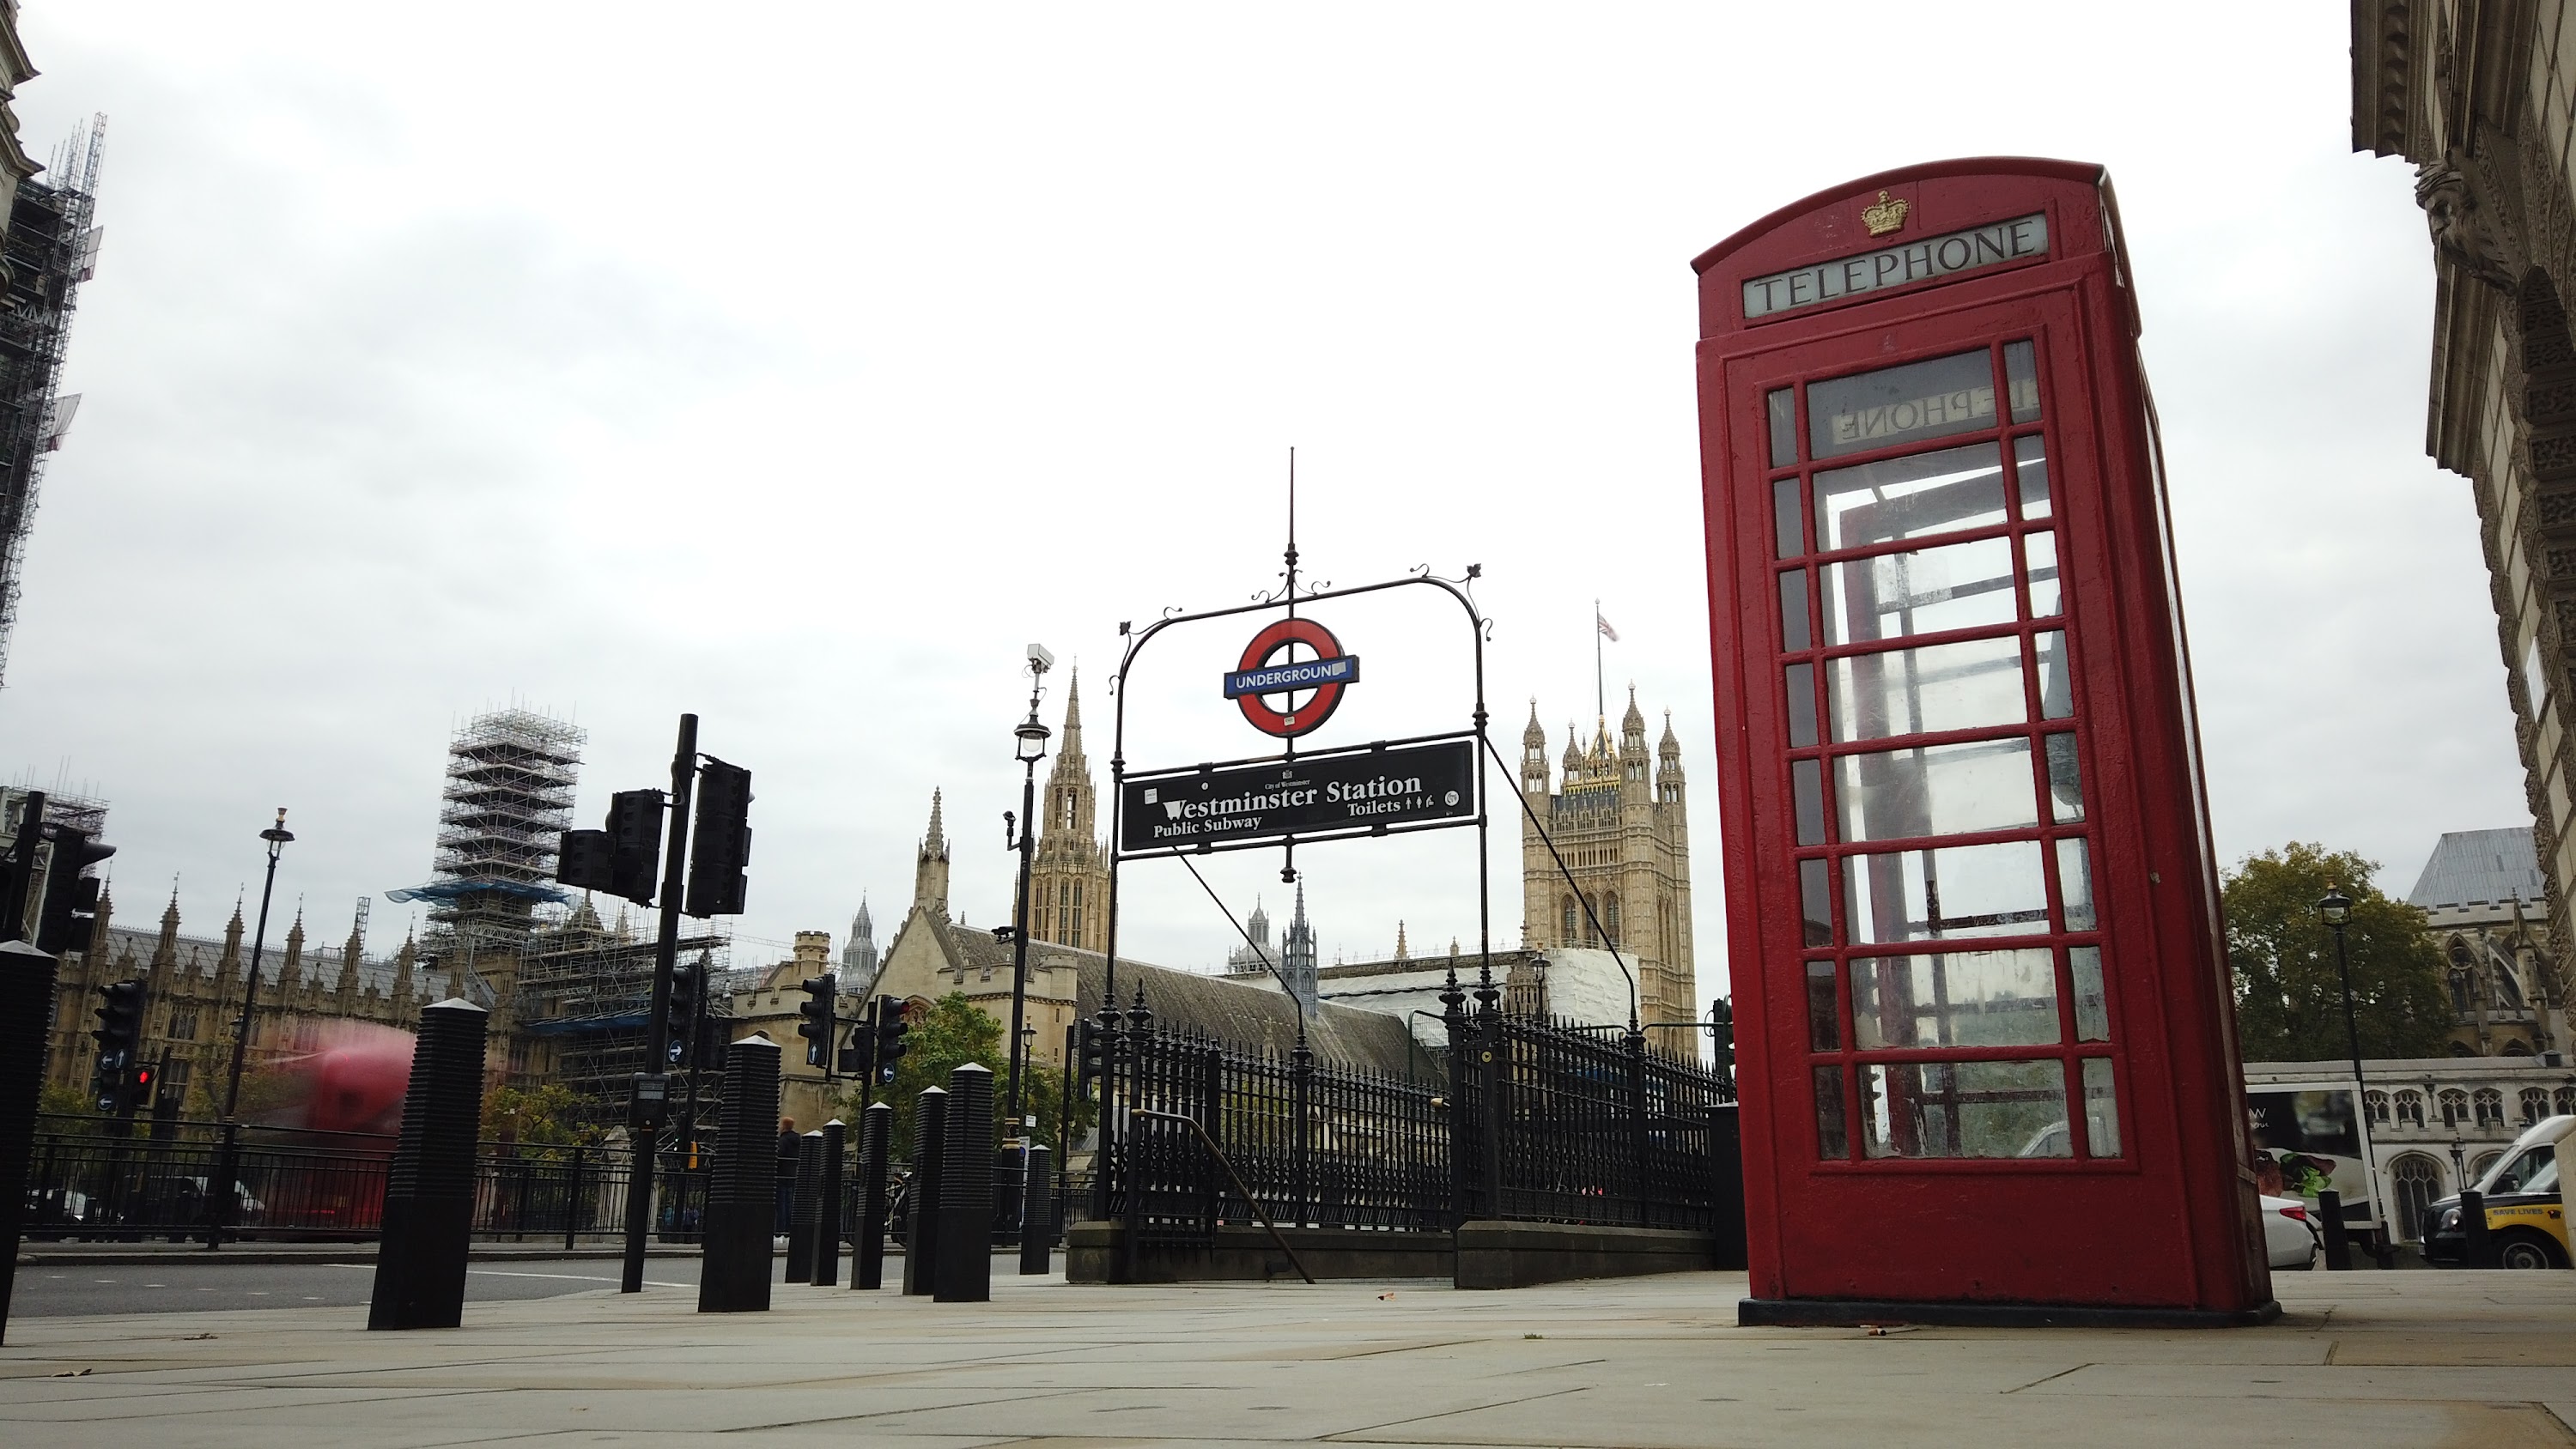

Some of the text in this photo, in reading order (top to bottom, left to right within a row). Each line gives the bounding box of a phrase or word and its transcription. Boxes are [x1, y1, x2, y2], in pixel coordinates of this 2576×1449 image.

[1753, 220, 2035, 312] TELEPHONE
[1326, 775, 1423, 803] Station
[1346, 799, 1401, 817] Toilets
[1153, 816, 1263, 839] Public Subway
